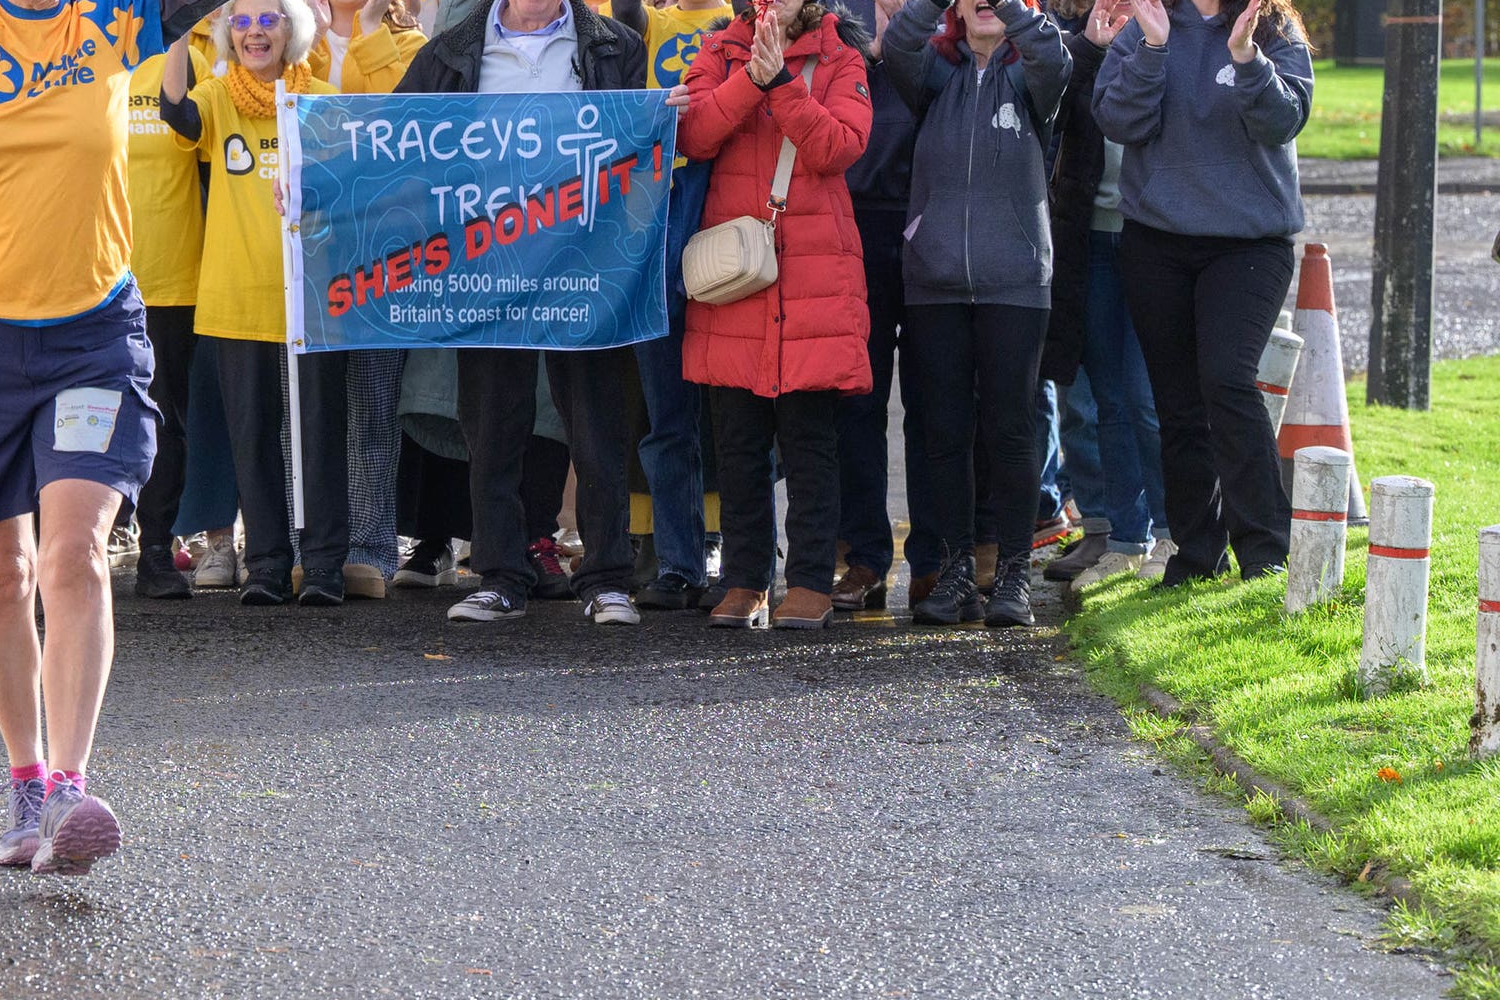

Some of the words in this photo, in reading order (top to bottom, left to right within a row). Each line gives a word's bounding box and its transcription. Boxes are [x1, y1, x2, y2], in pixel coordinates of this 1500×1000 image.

[341, 117, 542, 163] TRACEYS
[327, 231, 451, 318] SHE'S
[465, 173, 583, 261] DONE
[597, 151, 639, 206] IT
[383, 274, 443, 298] king
[448, 273, 492, 293] 5000
[496, 273, 539, 293] miles
[543, 273, 600, 293] around
[389, 304, 454, 324] Britain's
[458, 306, 501, 323] coast
[505, 303, 528, 320] for
[532, 304, 589, 322] cancer!
